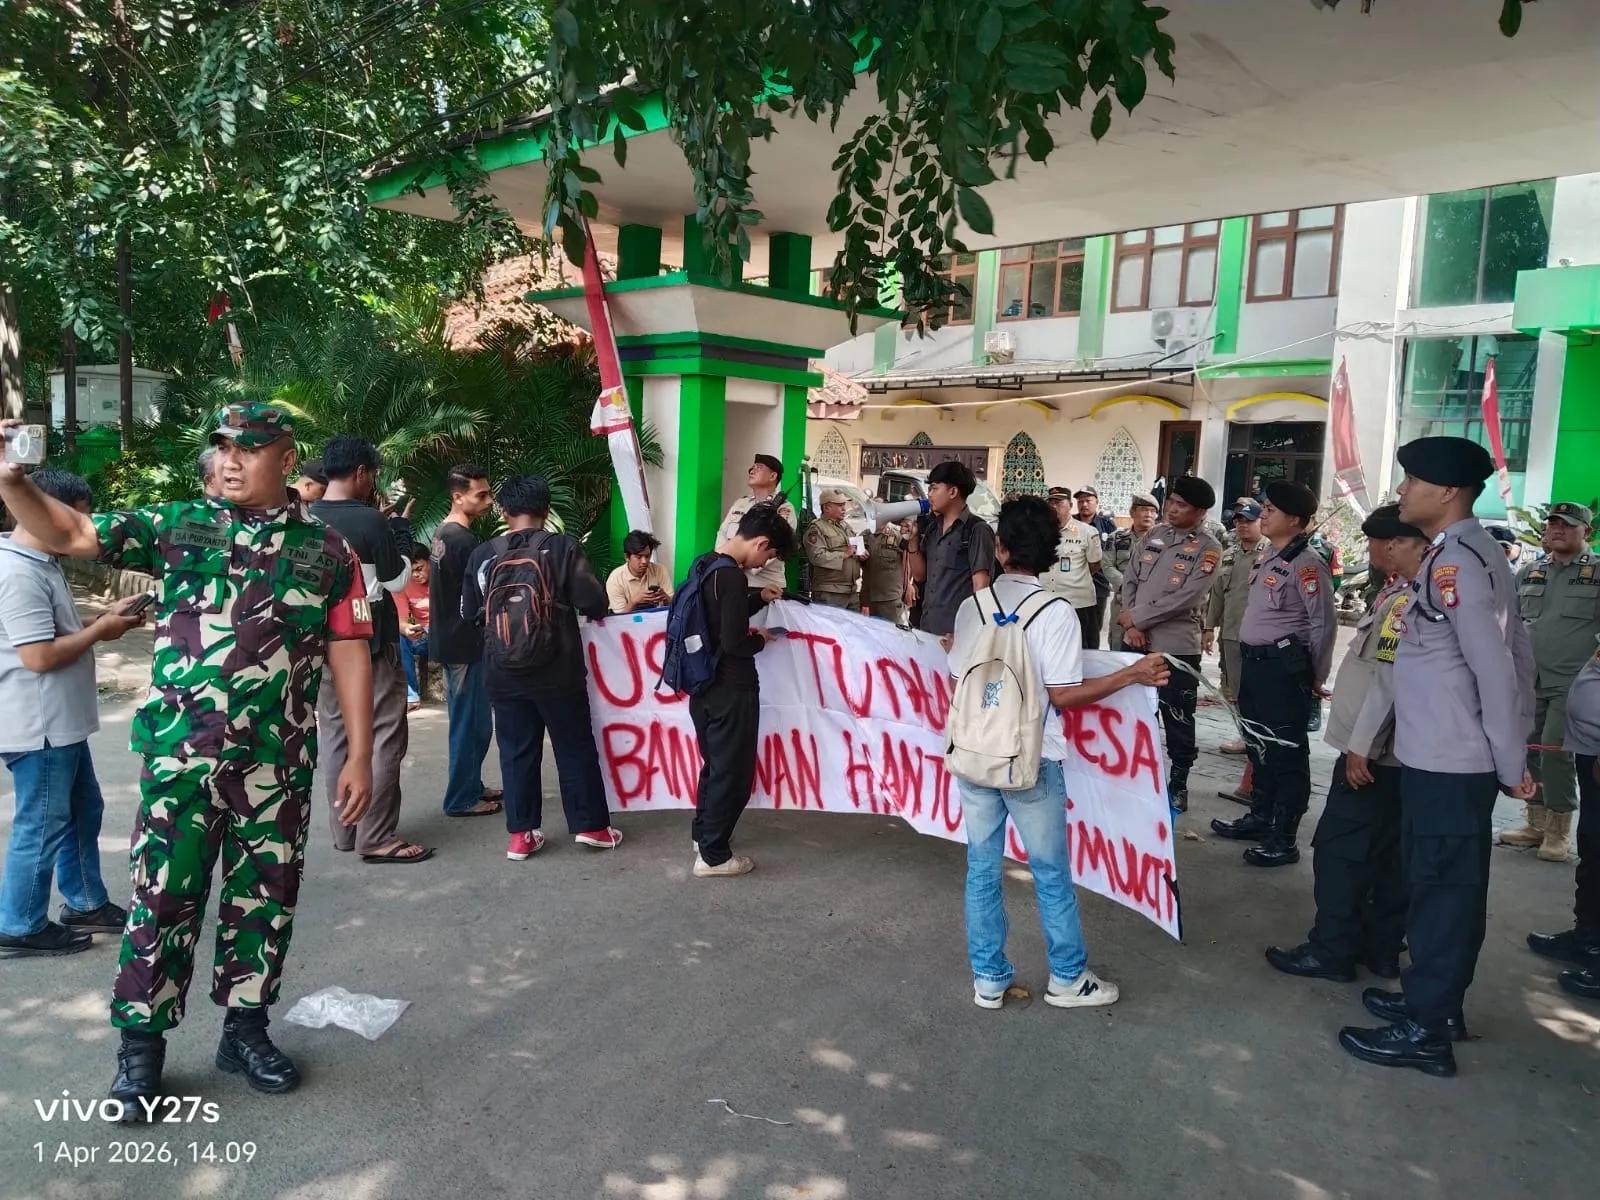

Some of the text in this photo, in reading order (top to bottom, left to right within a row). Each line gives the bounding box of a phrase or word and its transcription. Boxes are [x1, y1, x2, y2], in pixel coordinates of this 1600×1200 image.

[288, 548, 309, 560] TNI
[1175, 552, 1196, 563] POLRI
[1271, 566, 1290, 578] POLRI
